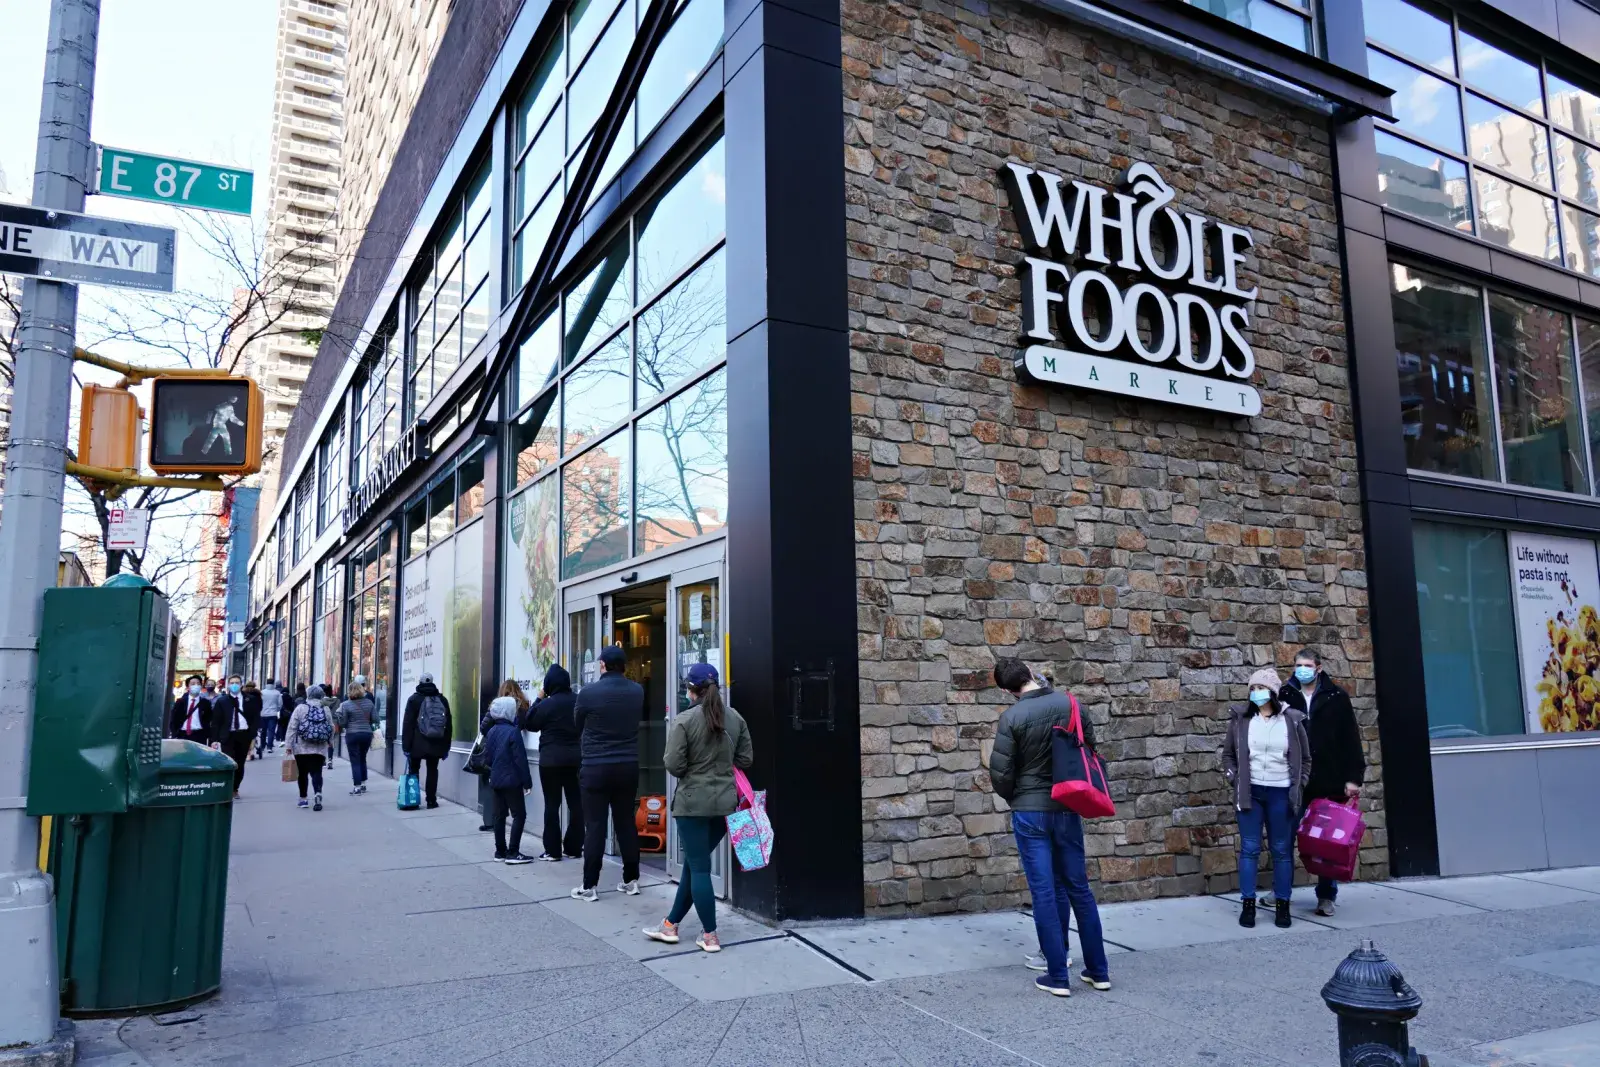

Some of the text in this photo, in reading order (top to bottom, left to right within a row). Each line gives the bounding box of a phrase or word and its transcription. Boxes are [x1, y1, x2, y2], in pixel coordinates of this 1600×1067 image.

[111, 155, 241, 200] E 87 ST
[70, 235, 144, 268] WAY
[1006, 162, 1258, 300] WHOLE
[1025, 256, 1256, 379] FOODS
[1043, 356, 1247, 408] MARKET
[381, 421, 419, 494] MARKET
[1517, 546, 1569, 565] Life without
[1519, 567, 1571, 583] pasta is not.
